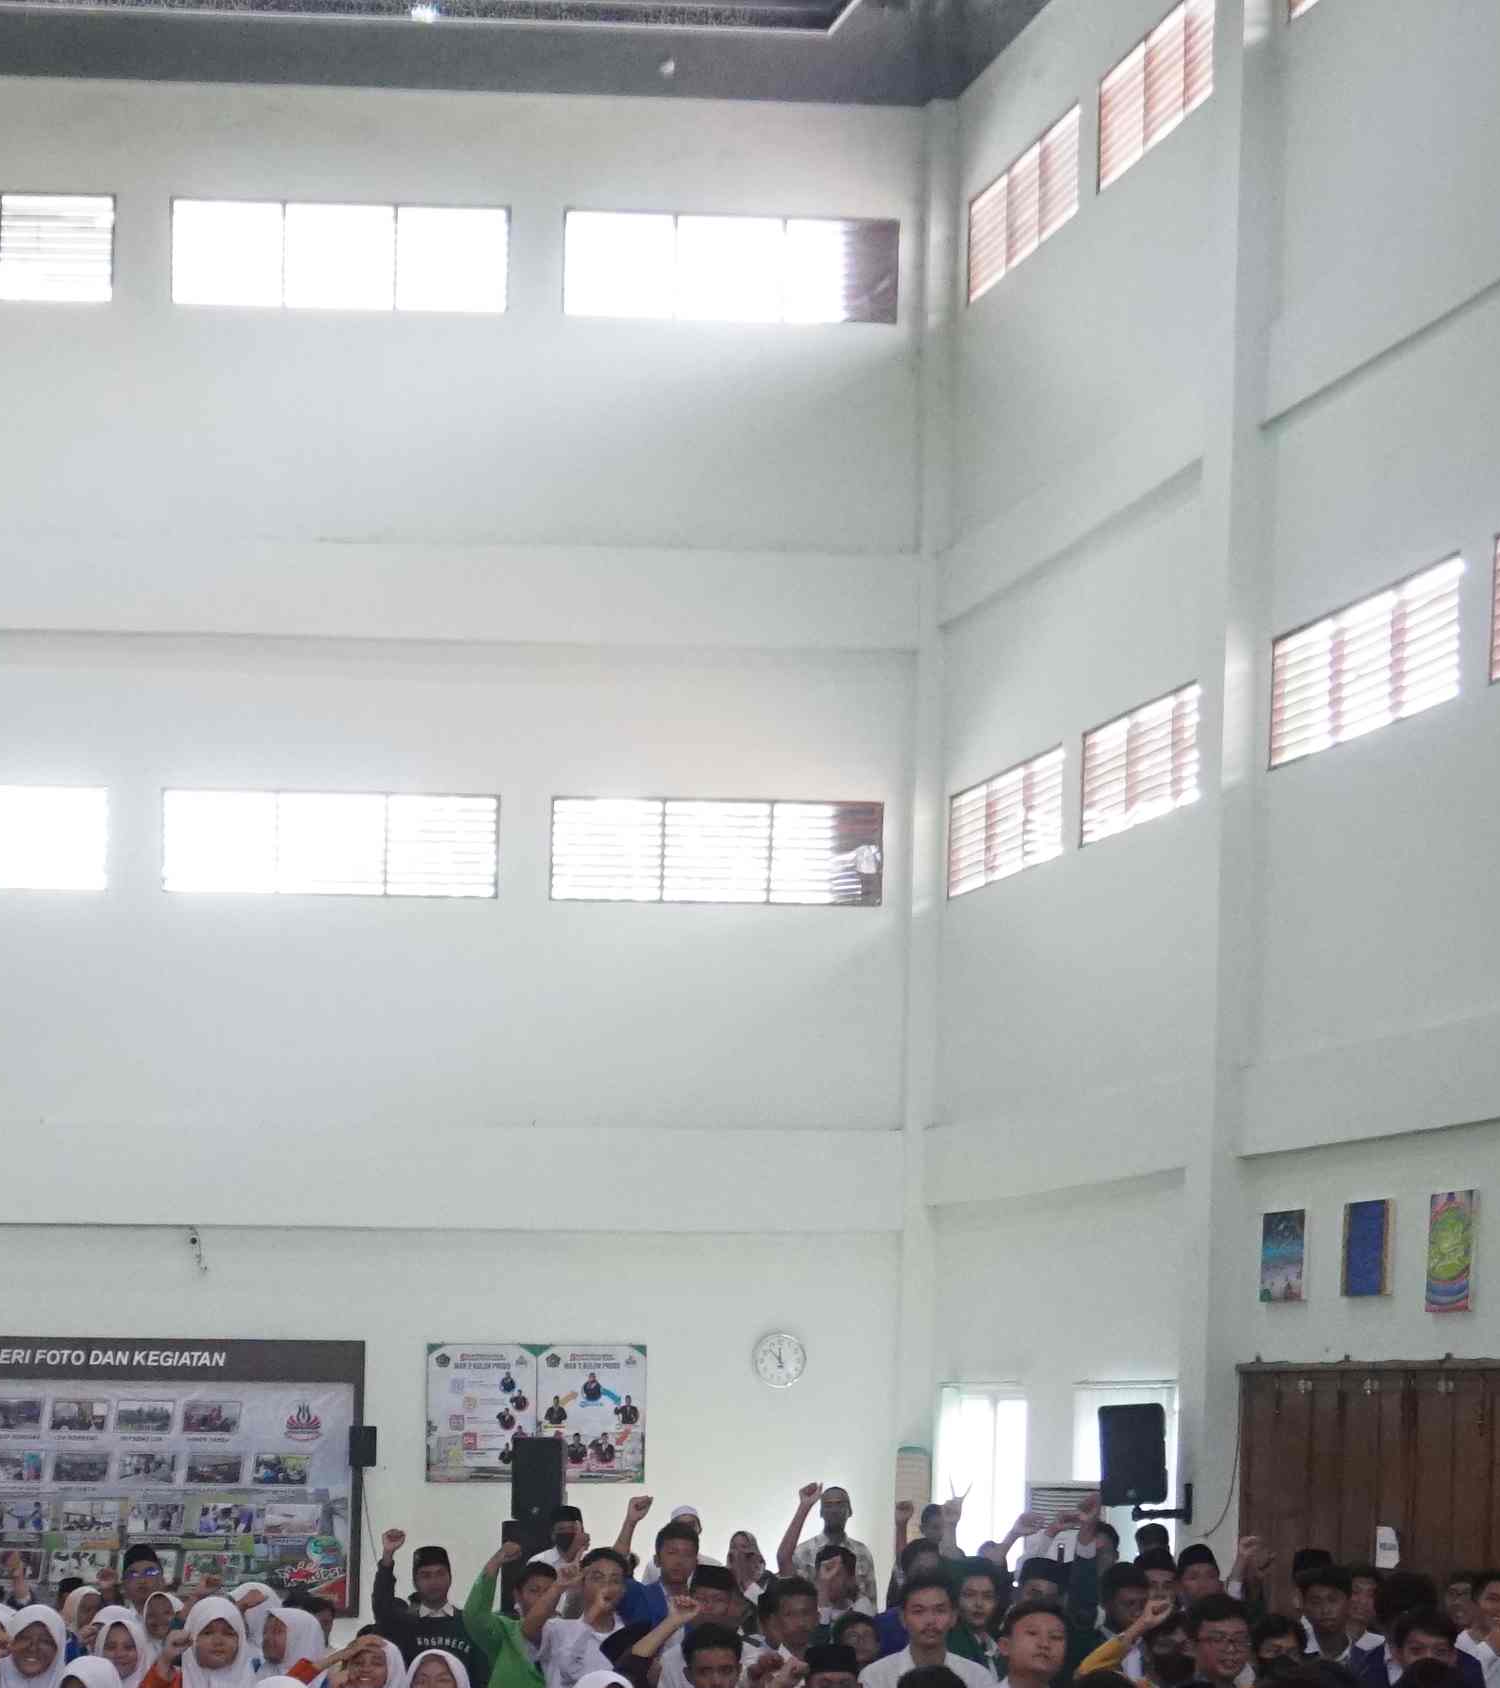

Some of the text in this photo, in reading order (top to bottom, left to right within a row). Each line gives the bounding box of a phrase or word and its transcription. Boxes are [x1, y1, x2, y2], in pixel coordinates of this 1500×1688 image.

[34, 1349, 86, 1365] FOTO
[88, 1350, 130, 1366] DAN
[132, 1351, 227, 1367] KEGIATAN
